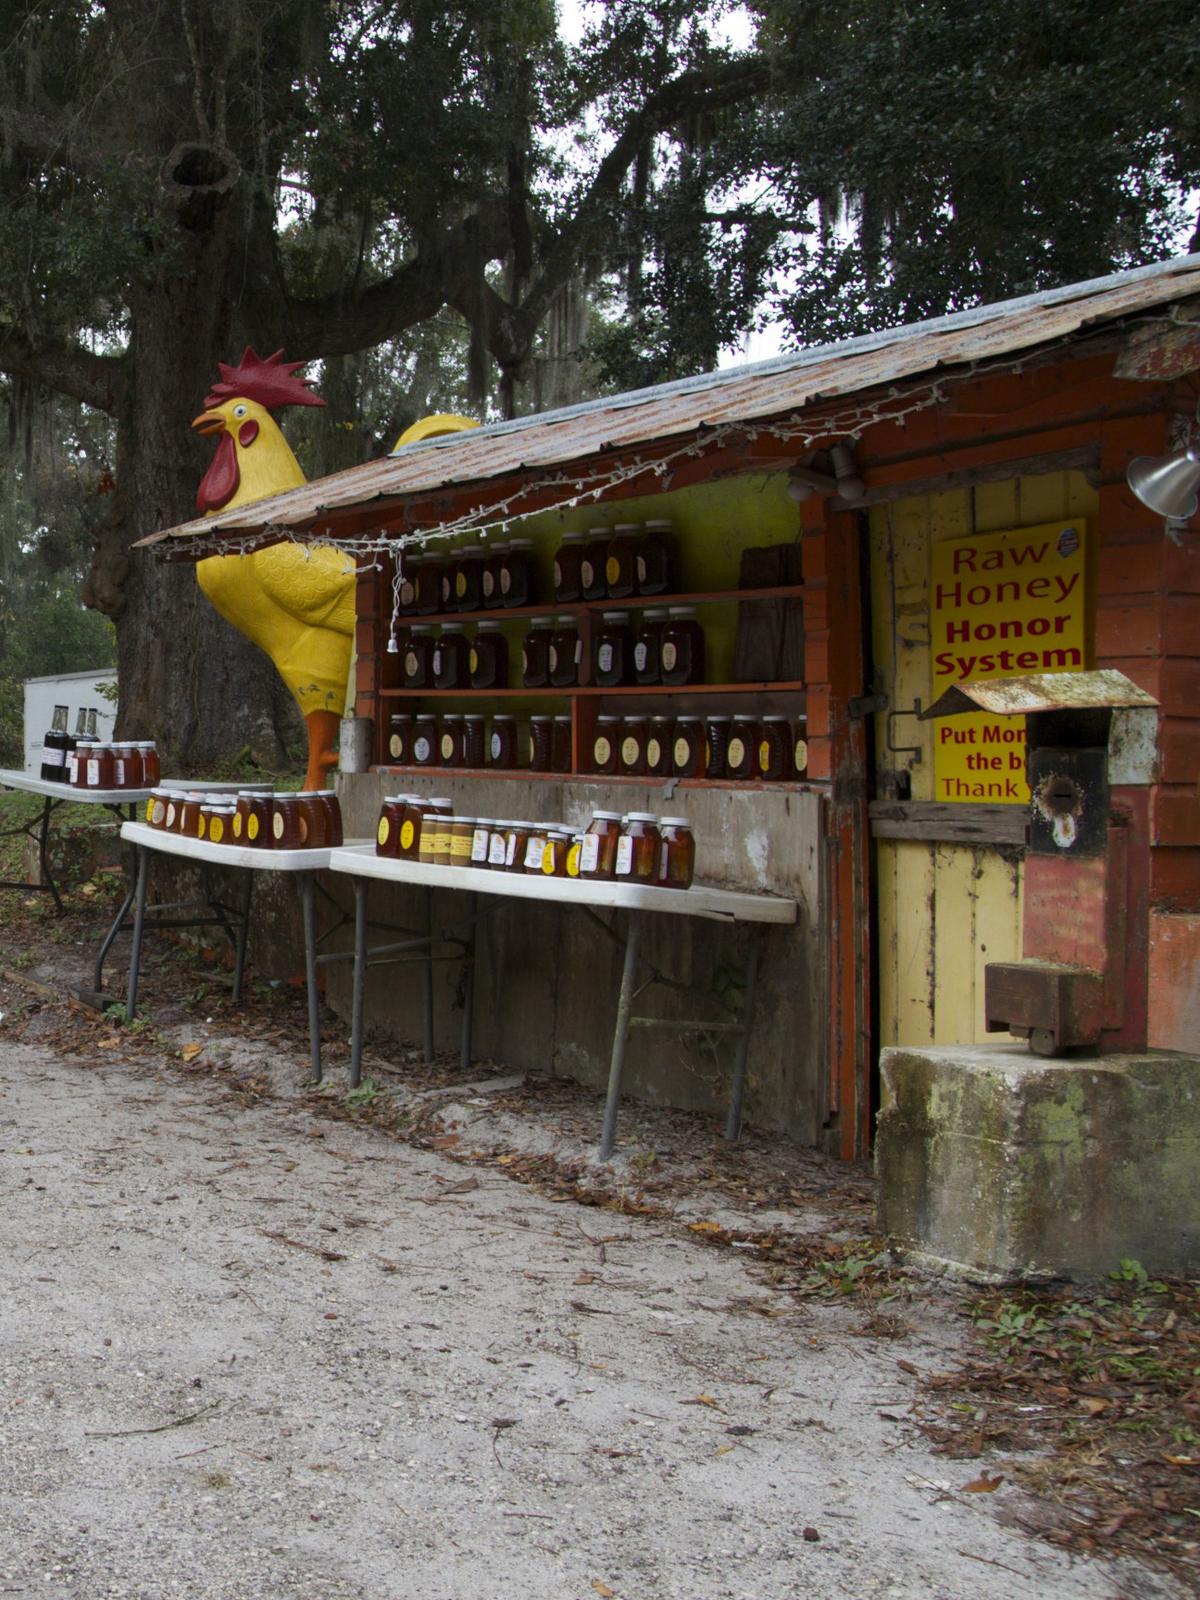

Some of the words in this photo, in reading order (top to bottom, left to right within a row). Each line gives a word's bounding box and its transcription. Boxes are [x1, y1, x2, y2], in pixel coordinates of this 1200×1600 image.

[954, 543, 1049, 575] Raw
[936, 573, 1079, 609] Honey
[946, 615, 1071, 644] Honor
[936, 648, 1080, 680] System
[941, 727, 976, 744] Put
[983, 725, 1026, 744] Mon
[966, 752, 1003, 770] the
[942, 778, 1018, 797] Thank
